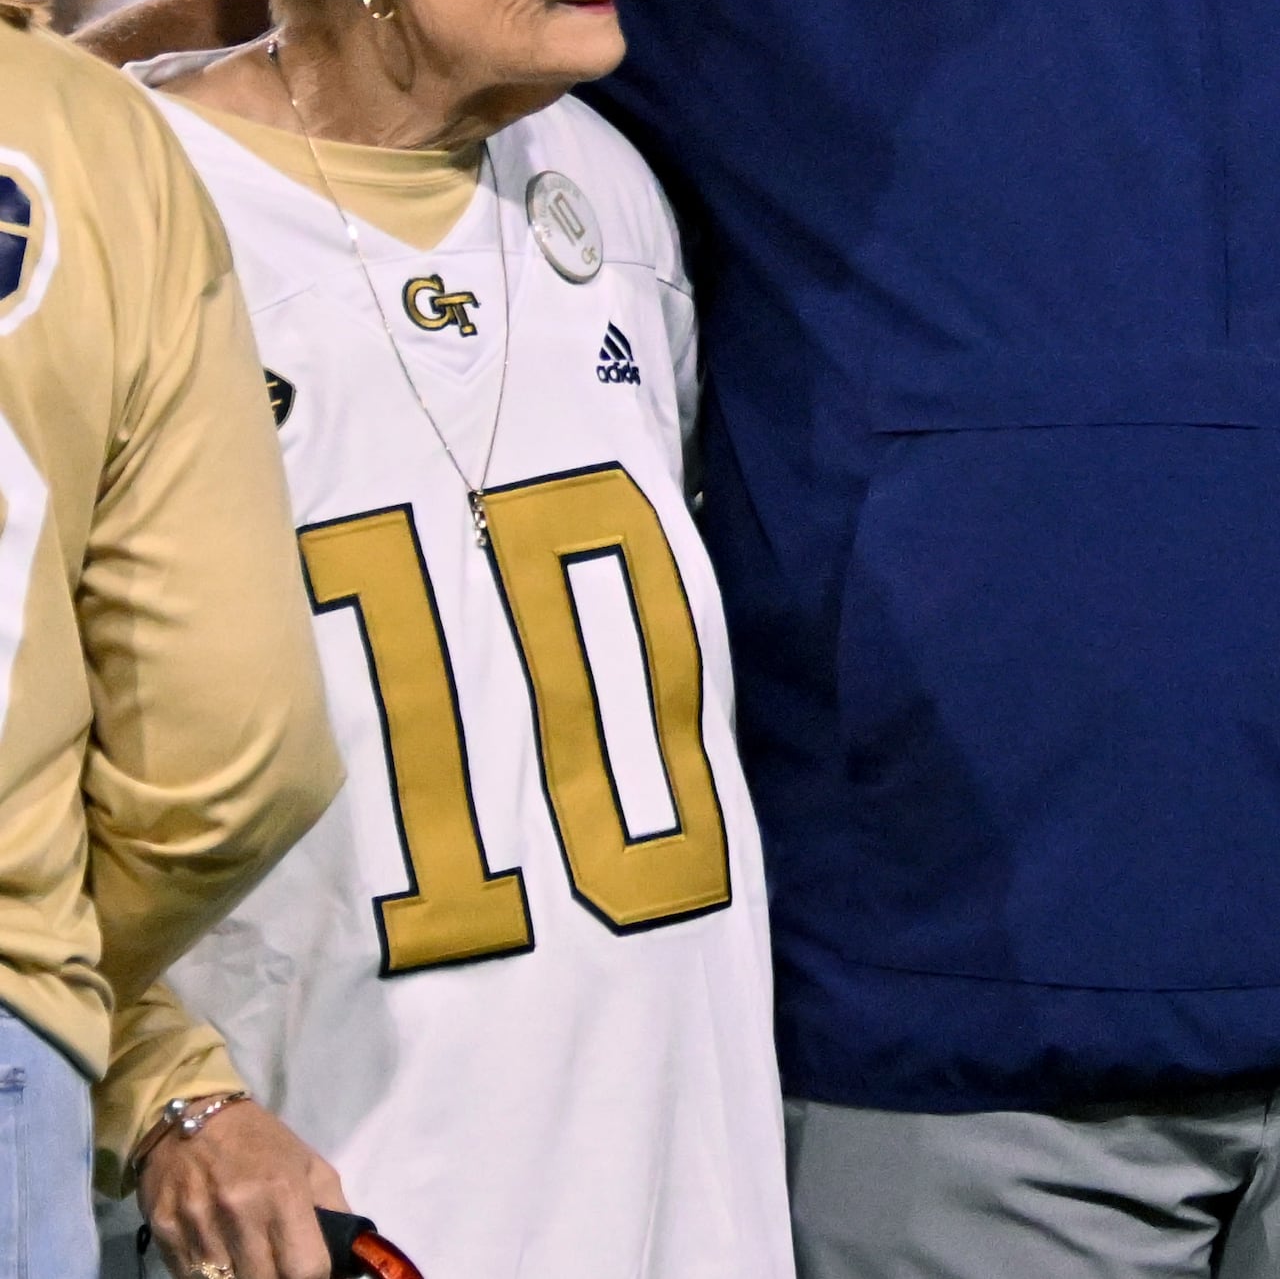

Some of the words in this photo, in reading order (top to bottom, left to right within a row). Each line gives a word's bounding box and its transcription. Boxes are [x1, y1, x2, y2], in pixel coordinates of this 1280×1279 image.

[402, 274, 481, 337] GT
[596, 361, 641, 386] adidas
[297, 462, 732, 977] 10
